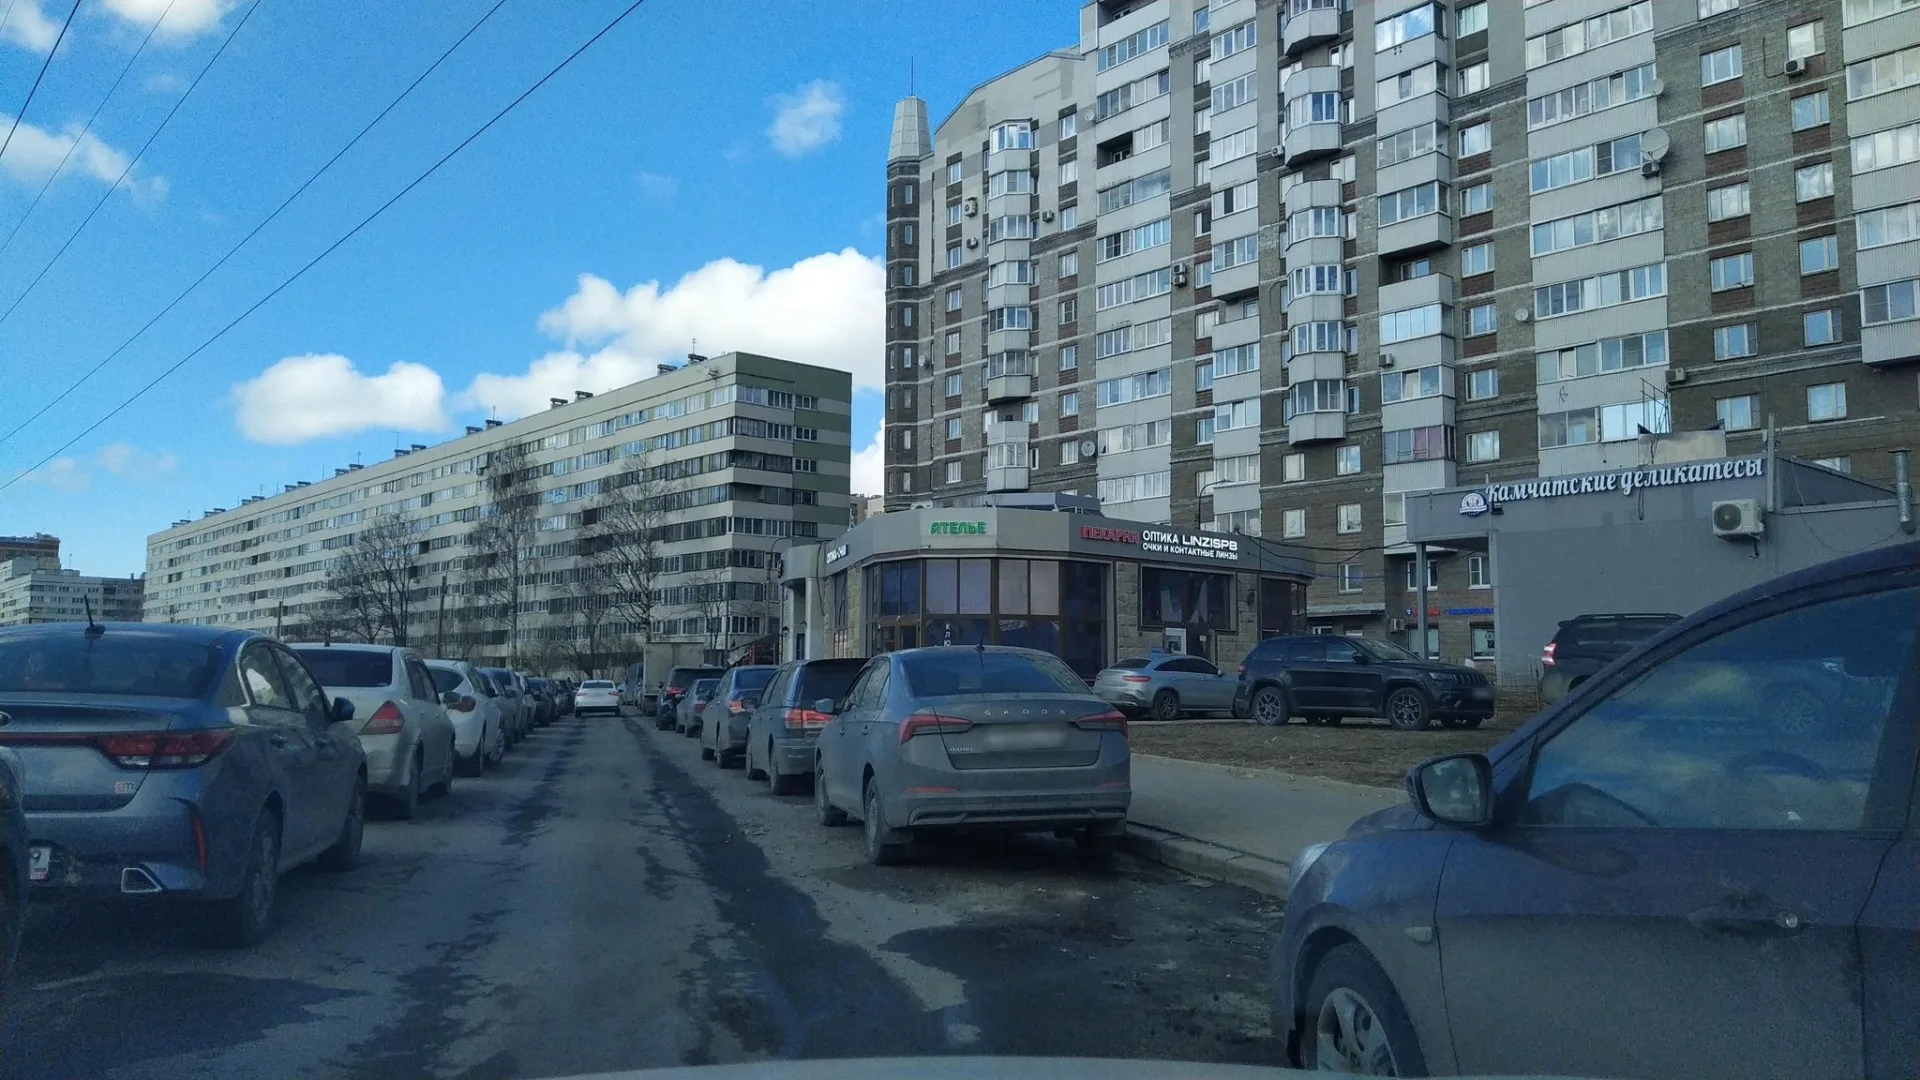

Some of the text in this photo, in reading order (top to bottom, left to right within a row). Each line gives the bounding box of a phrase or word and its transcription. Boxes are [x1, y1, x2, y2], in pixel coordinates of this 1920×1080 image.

[1621, 457, 1764, 496] деликатесы
[930, 521, 986, 535] АТЕЛЬЕ
[1142, 530, 1238, 551] ОПТИКА LINZISPB
[1163, 545, 1169, 553] И
[1169, 546, 1215, 558] КОНТАКТНЫЕ
[1215, 551, 1238, 560] ЛИНЗЫ
